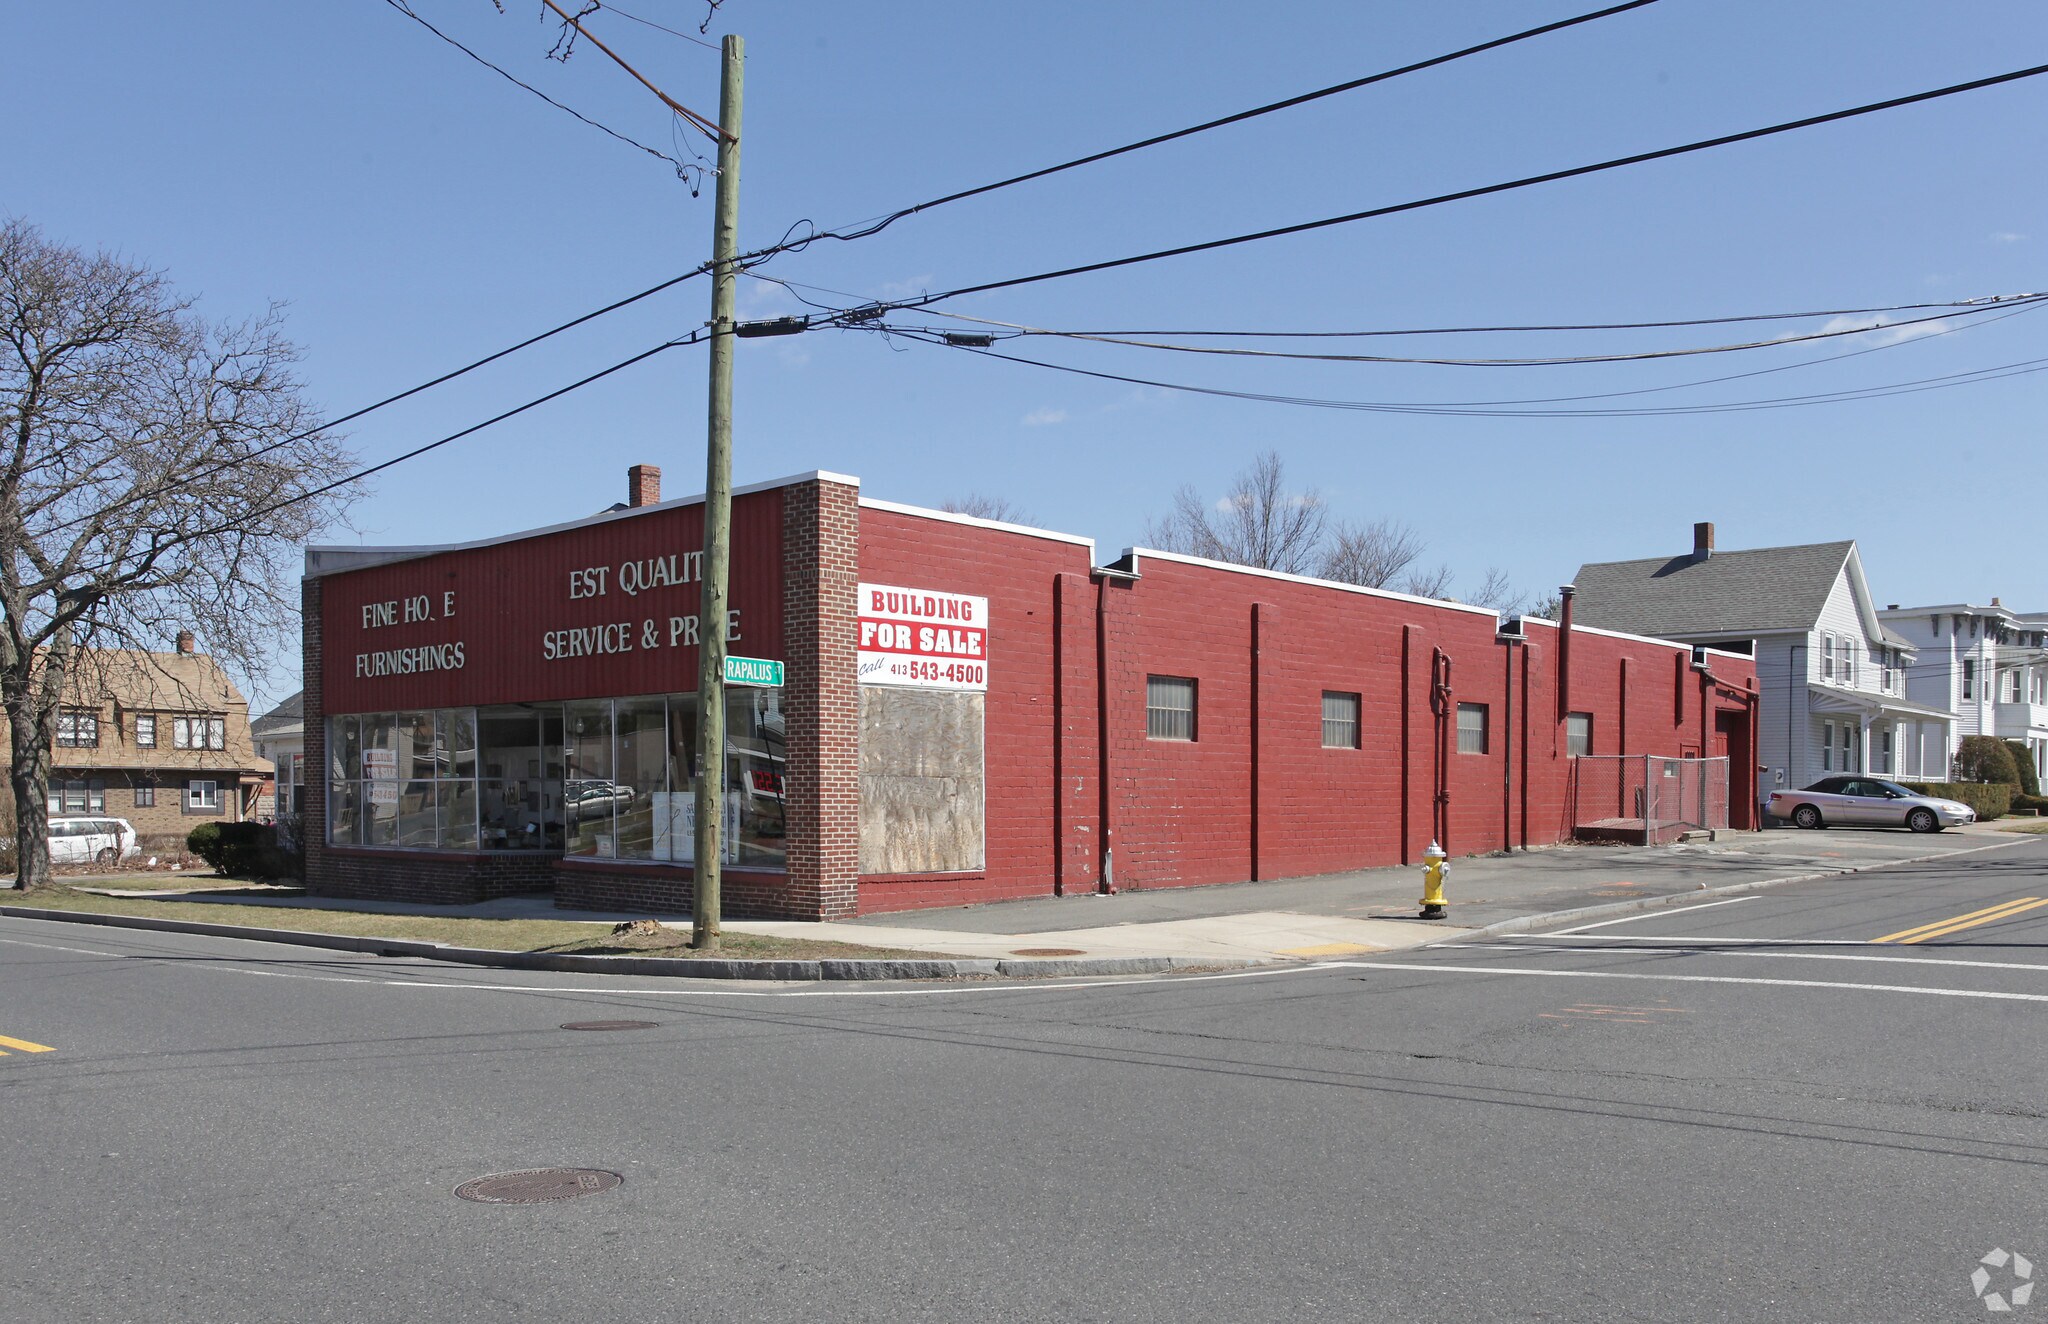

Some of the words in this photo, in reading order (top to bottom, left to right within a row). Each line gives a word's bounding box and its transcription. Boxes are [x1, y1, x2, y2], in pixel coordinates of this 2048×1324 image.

[569, 566, 609, 599] EST
[618, 551, 704, 595] QUALIT
[362, 601, 398, 629] FINE
[871, 590, 972, 621] BUILDING
[543, 622, 633, 661] SERVICE
[641, 618, 660, 650] &
[669, 609, 742, 647] PRE
[860, 621, 912, 650] FOR
[919, 626, 982, 656] SALE
[355, 641, 465, 678] FURNISHINGS
[727, 660, 772, 681] RAPALUS
[890, 664, 908, 675] 413
[910, 661, 983, 684] 543-4500
